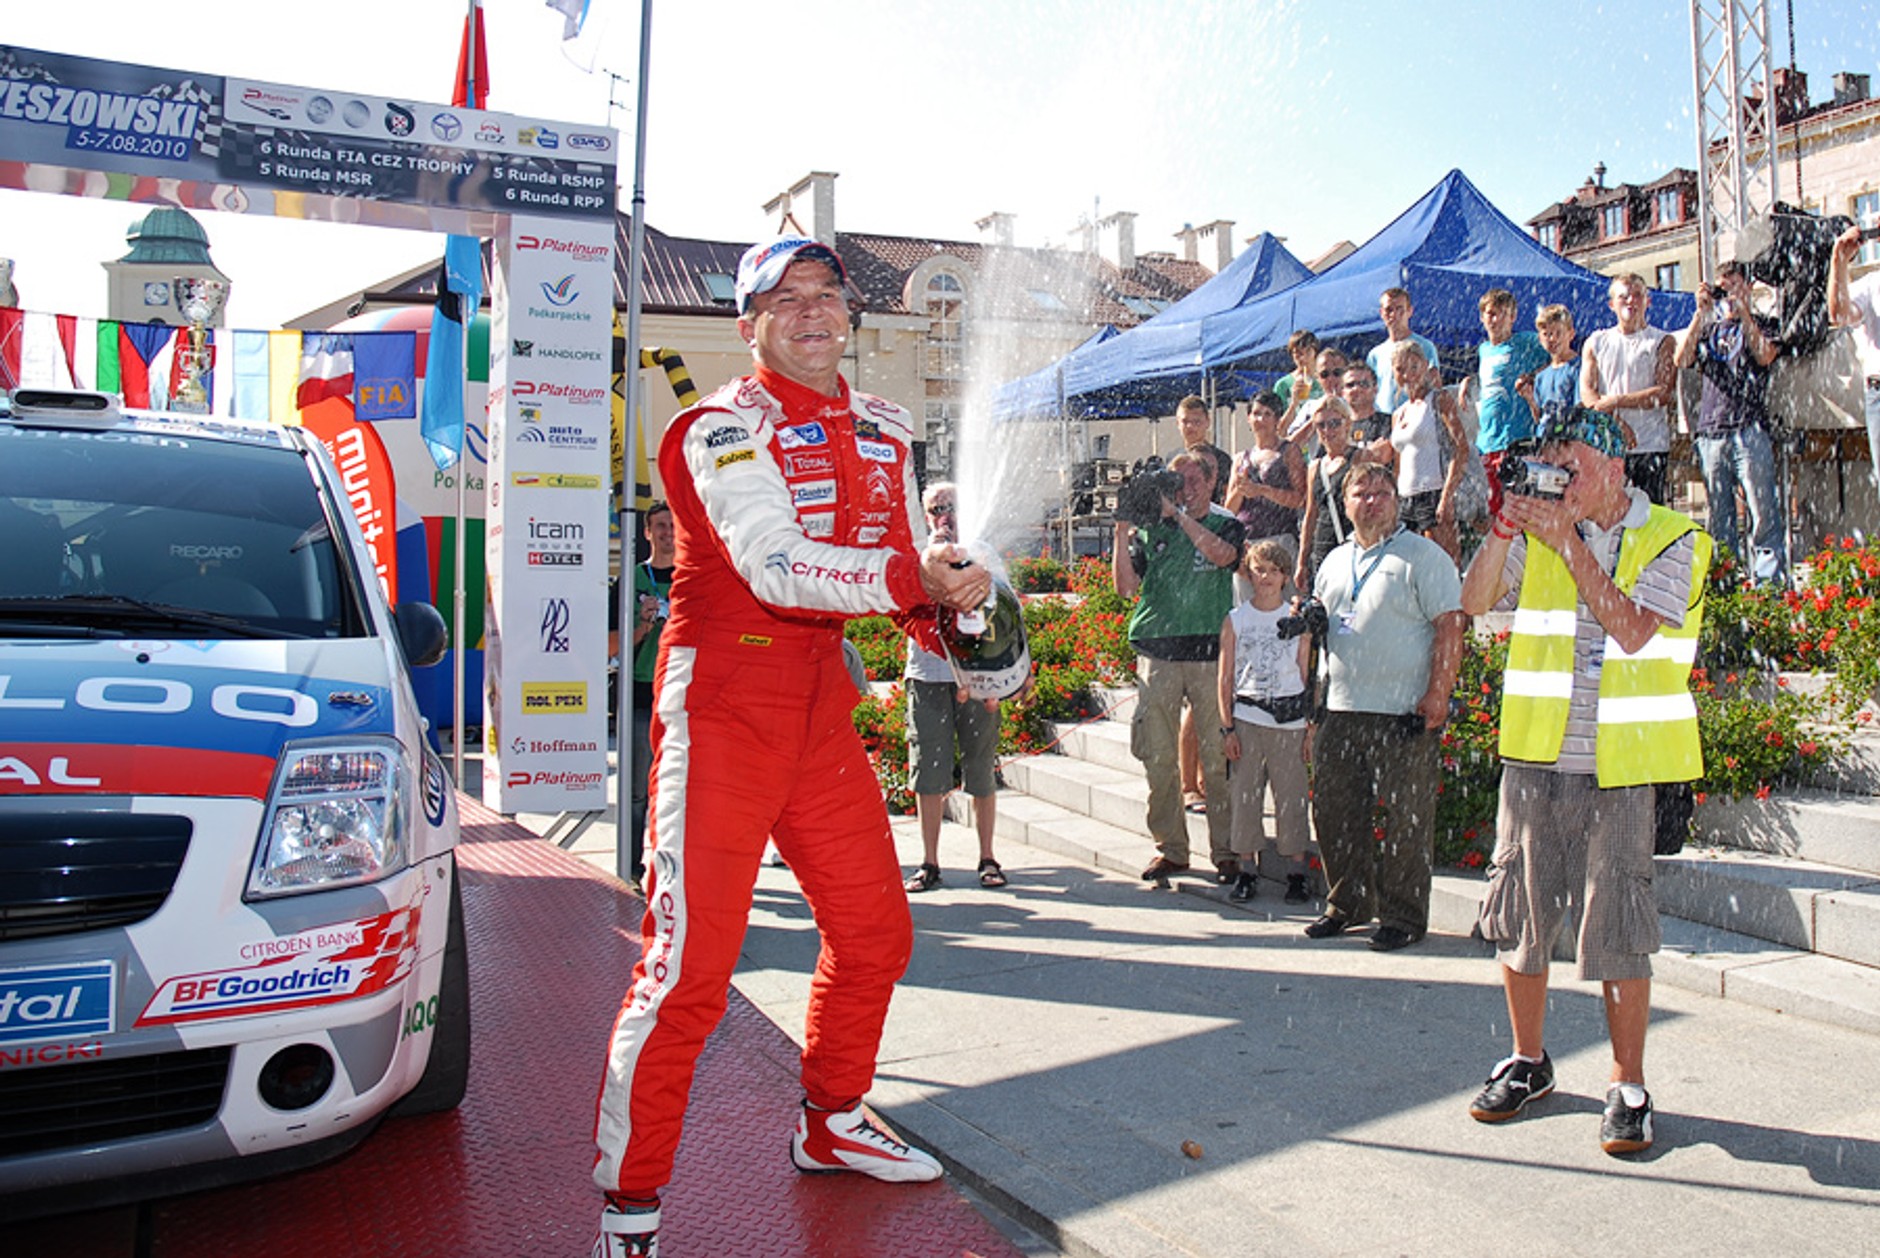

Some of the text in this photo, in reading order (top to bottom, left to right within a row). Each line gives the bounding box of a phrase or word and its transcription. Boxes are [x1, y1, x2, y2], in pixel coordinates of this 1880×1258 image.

[76, 130, 187, 159] 5-7.08.2010
[261, 141, 474, 176] 6 Runda FIA CEZ TROPHY
[260, 163, 373, 185] 5 Runda MSR
[493, 167, 605, 189] 5 Runda RSMP
[506, 188, 604, 208] 6 Runda RPP
[541, 238, 609, 256] Platinum
[359, 384, 405, 406] FIA
[537, 382, 605, 399] Platinum
[548, 435, 598, 445] CENTRUM
[549, 426, 583, 436] auto
[529, 517, 584, 538] icam
[170, 544, 243, 559] RECARO
[529, 553, 582, 564] HOTEL
[530, 740, 597, 753] Hoffman
[534, 771, 602, 784] Platinum
[317, 929, 363, 949] BANK
[172, 964, 350, 1004] BFGoodrich
[401, 994, 439, 1041] AQQ
